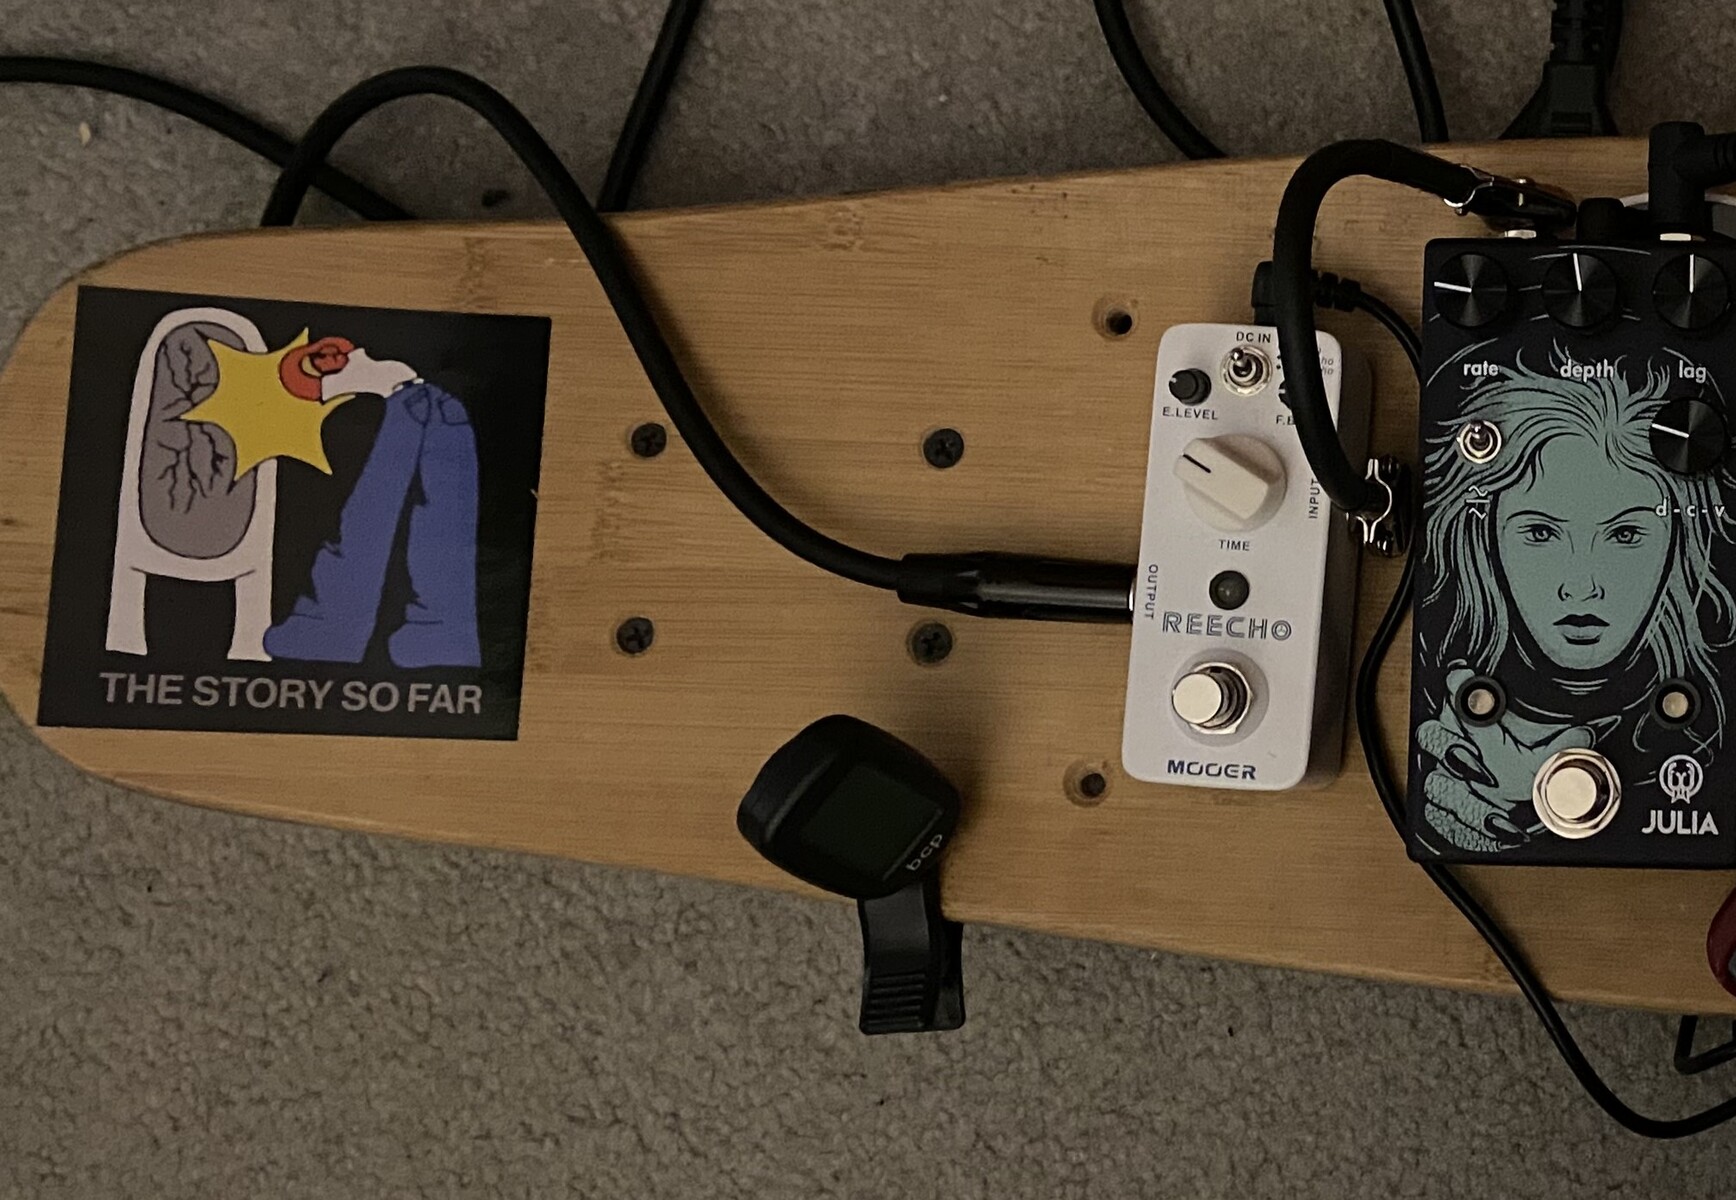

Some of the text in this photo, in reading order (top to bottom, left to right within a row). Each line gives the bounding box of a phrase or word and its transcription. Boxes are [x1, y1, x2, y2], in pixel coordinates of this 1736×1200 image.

[1236, 331, 1271, 344] DC IN
[1463, 360, 1499, 377] rate
[1560, 359, 1615, 382] depth
[1679, 360, 1707, 383] lag
[1162, 406, 1219, 421] E.LEVEL
[1308, 479, 1320, 519] INPUT
[1219, 539, 1250, 551] TIME
[1144, 563, 1159, 620] OUTPUT
[1162, 610, 1292, 641] REECHO
[99, 671, 483, 715] THE STORY SO FAR
[1167, 758, 1256, 780] MOOER
[1642, 810, 1719, 835] JULIA
